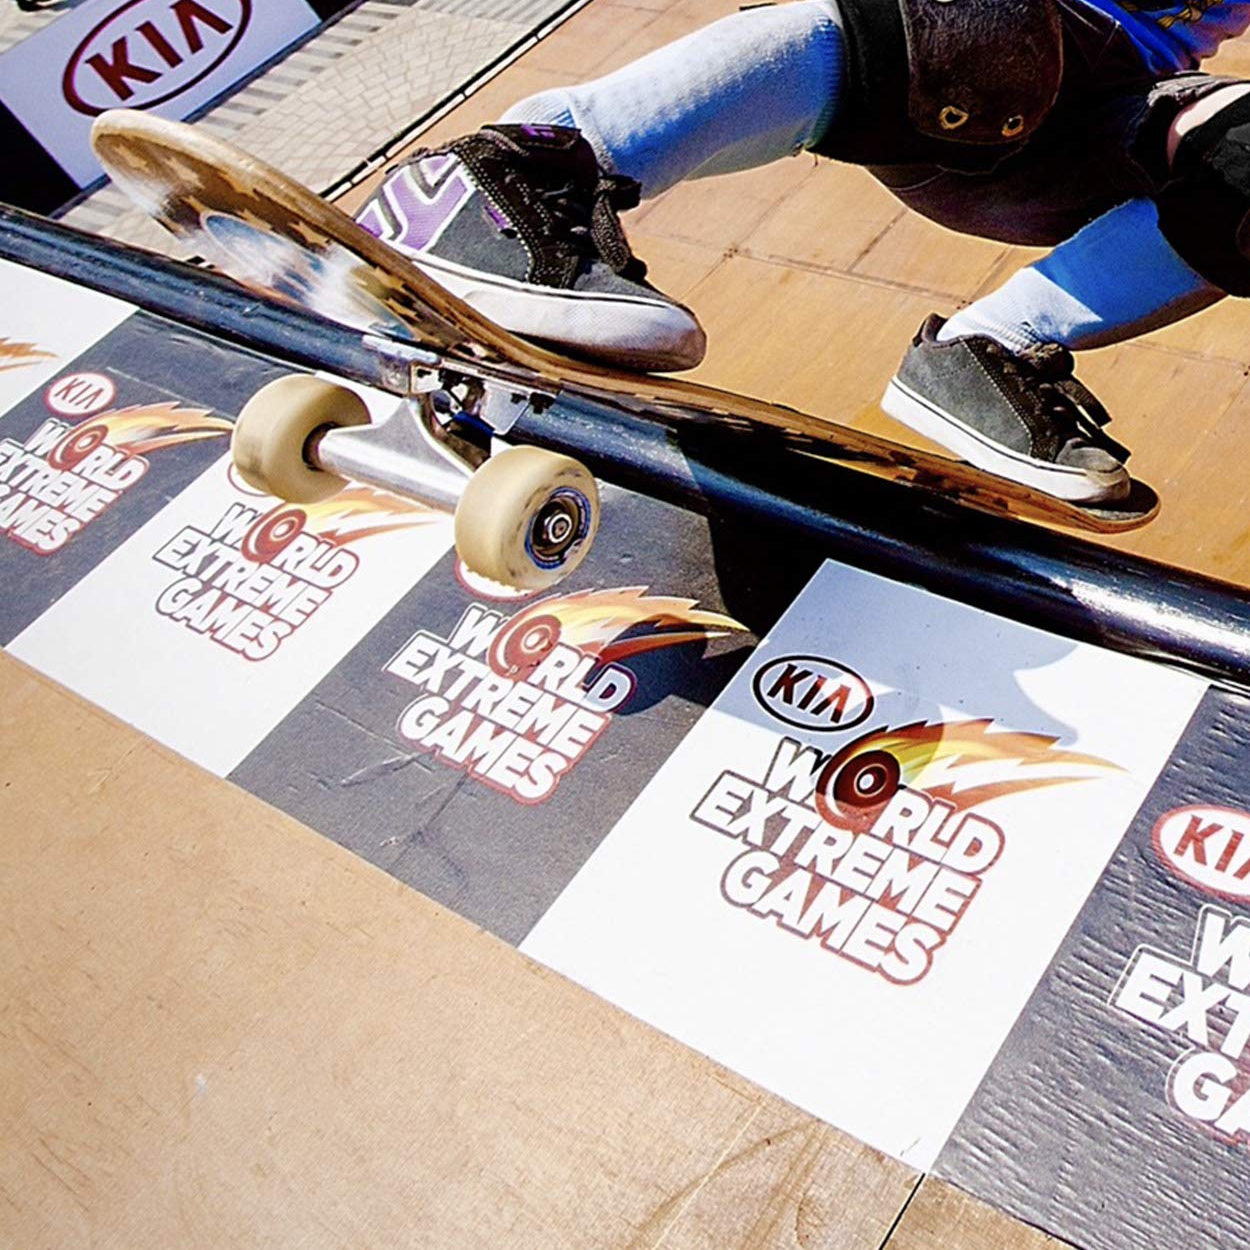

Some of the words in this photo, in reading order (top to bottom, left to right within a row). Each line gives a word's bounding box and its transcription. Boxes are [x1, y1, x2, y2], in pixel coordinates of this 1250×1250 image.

[54, 378, 103, 407] KIA
[0, 483, 86, 556] AMES
[152, 525, 333, 629] EXTREME
[155, 576, 295, 662] GAMES
[382, 630, 612, 762] EXTREME
[767, 662, 854, 724] KIA
[397, 693, 569, 806] GAMES
[689, 770, 983, 935] EXTREME
[720, 849, 948, 986] GAMES
